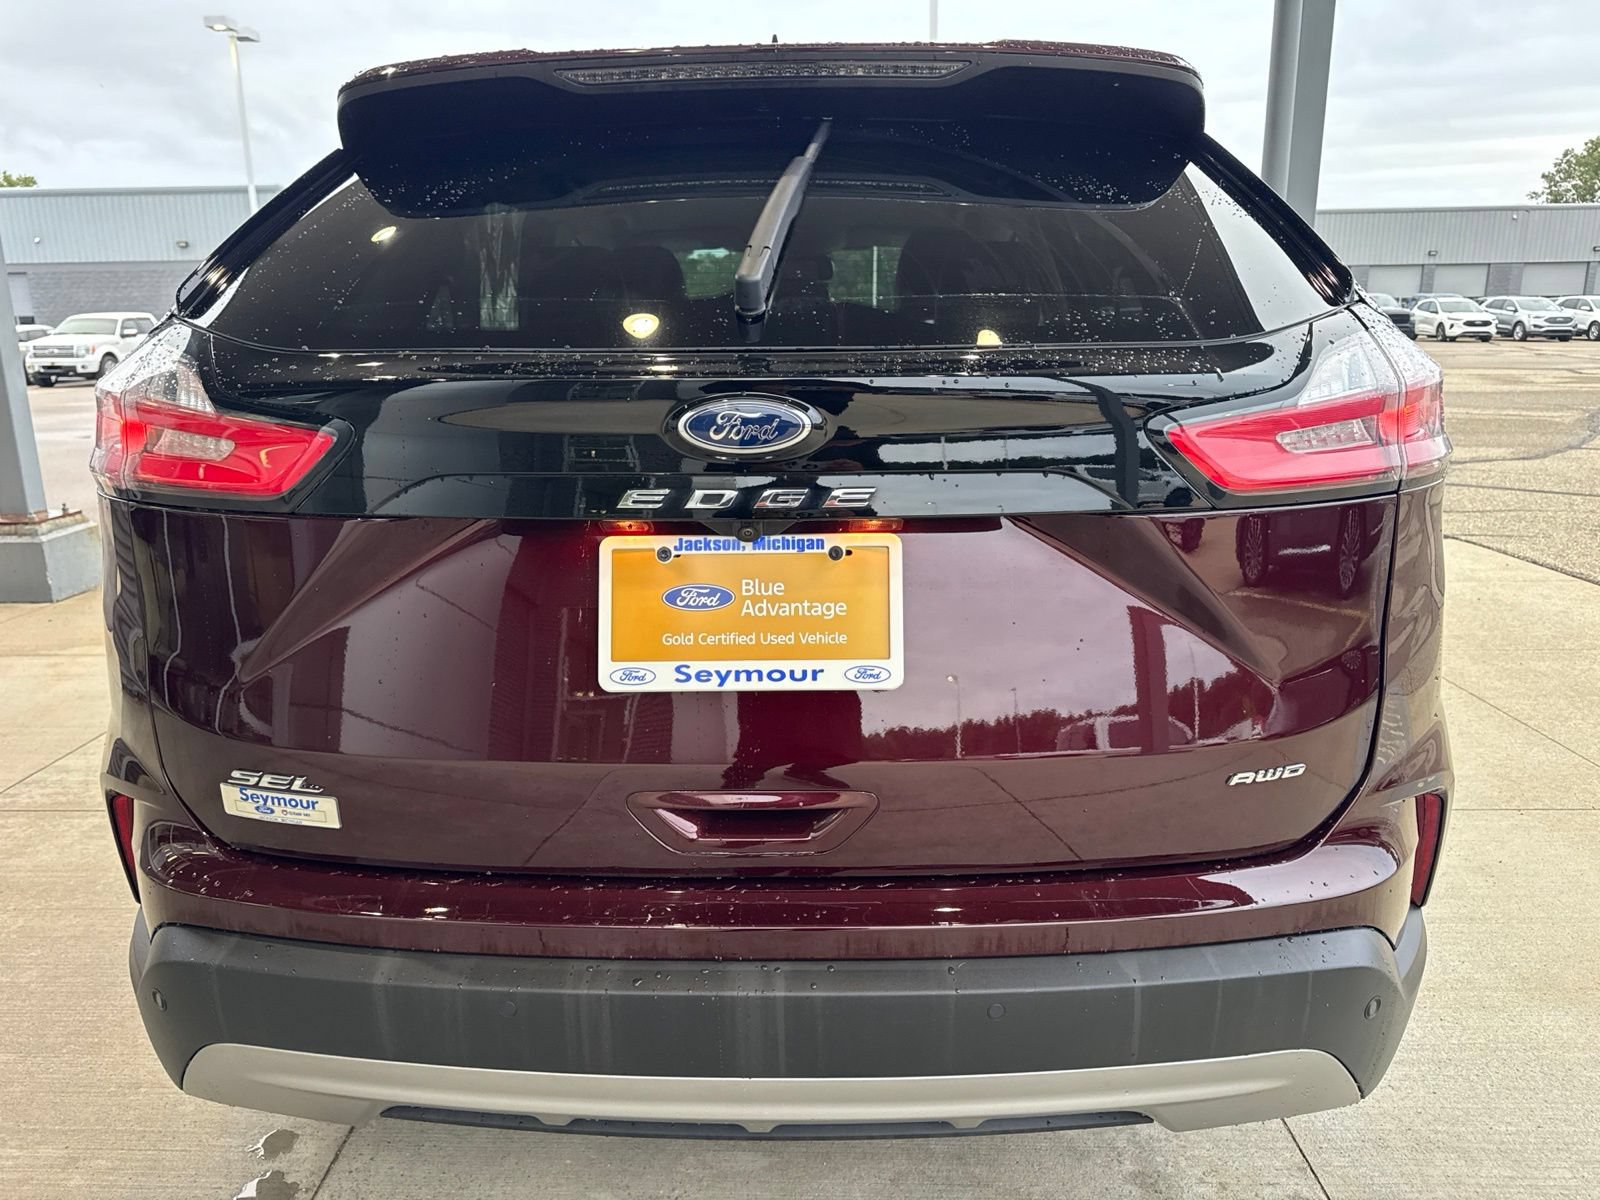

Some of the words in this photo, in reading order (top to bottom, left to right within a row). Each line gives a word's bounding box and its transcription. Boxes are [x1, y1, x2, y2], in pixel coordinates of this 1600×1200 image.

[709, 409, 780, 441] Ford
[616, 487, 877, 509] EDGE
[673, 537, 746, 552] Jackson,
[752, 535, 825, 553] Michigan
[676, 587, 721, 607] Ford
[741, 578, 785, 596] Blue
[741, 599, 848, 619] Advantage
[662, 632, 694, 645] Gold
[698, 632, 756, 645] Certified
[760, 632, 795, 645] Used
[798, 632, 848, 645] Vehicle
[619, 669, 647, 682] Ford
[674, 664, 825, 687] Seymour
[853, 668, 882, 681] Ford
[227, 769, 324, 793] SEL
[1226, 763, 1307, 786] AWD
[239, 786, 319, 810] Seymour
